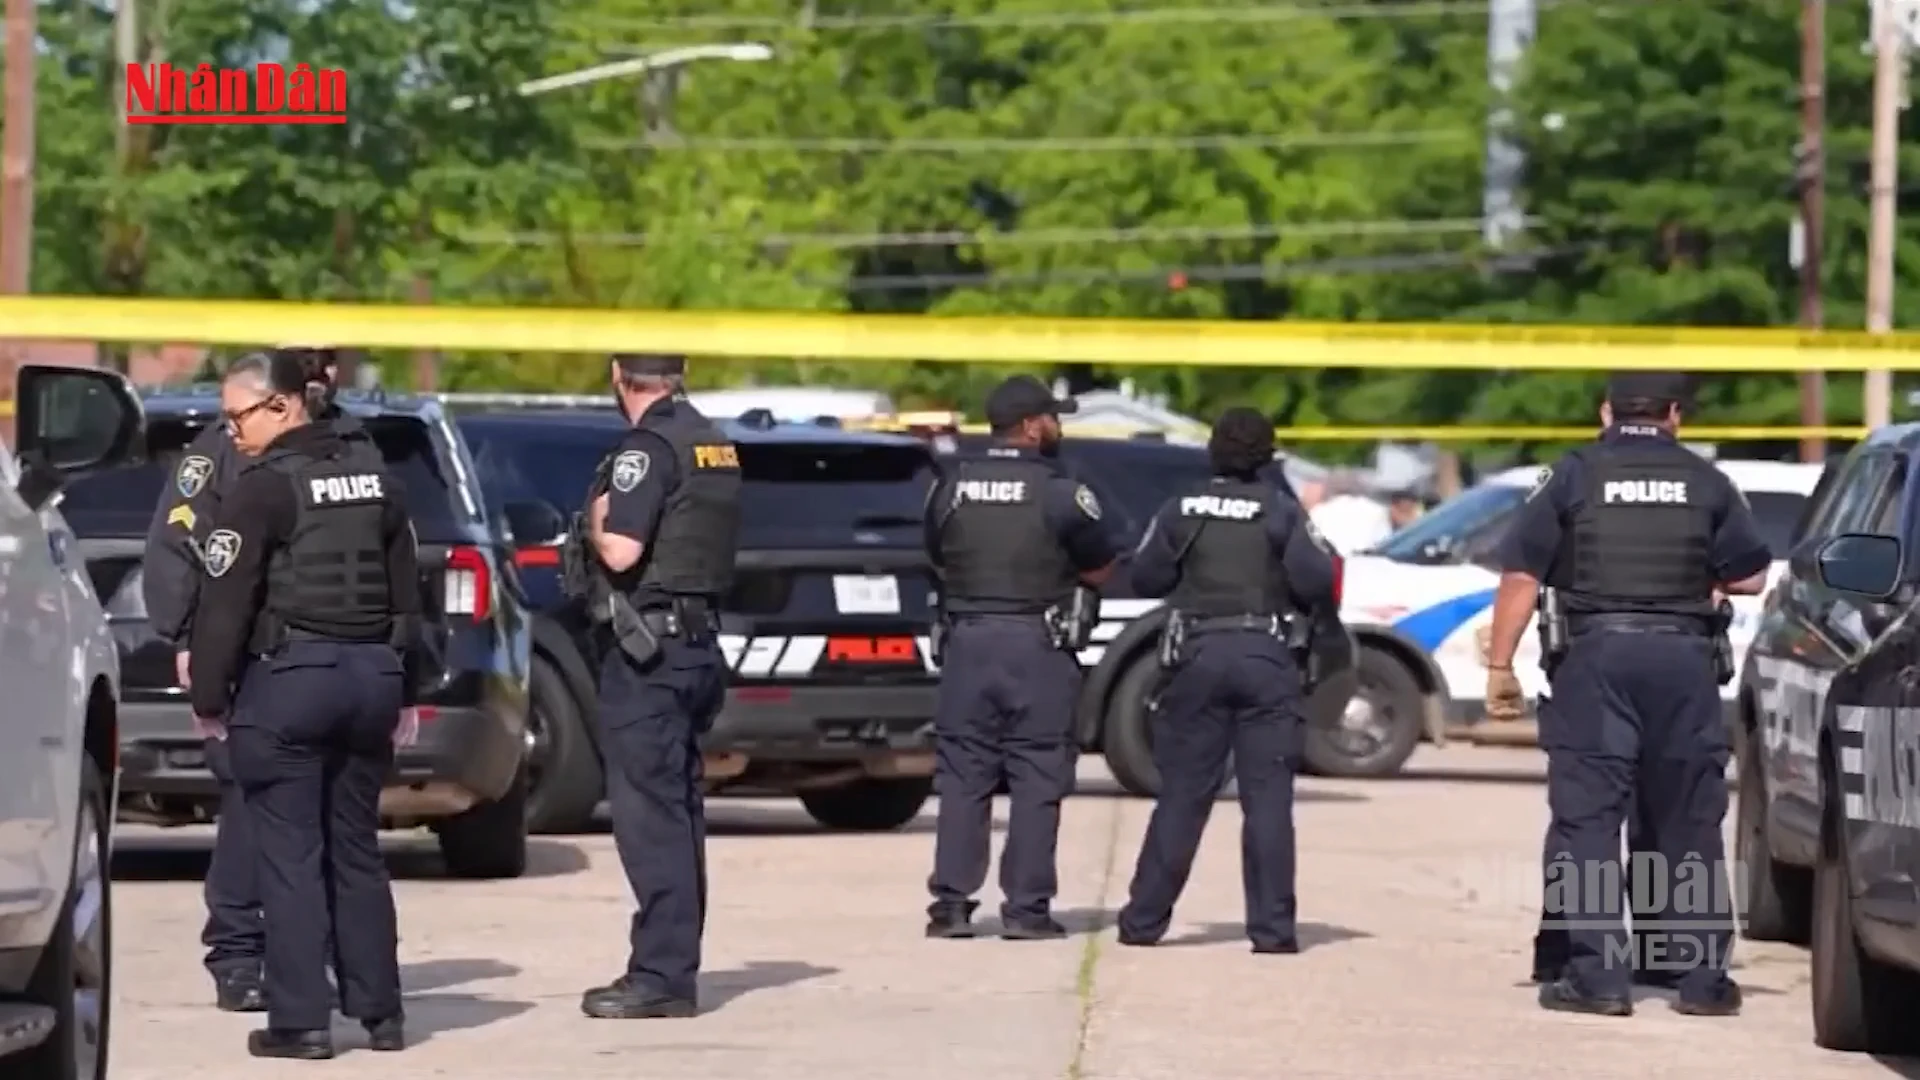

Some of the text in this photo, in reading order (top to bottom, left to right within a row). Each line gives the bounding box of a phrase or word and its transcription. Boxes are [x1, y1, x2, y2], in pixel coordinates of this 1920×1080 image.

[310, 474, 384, 505] POLICE
[955, 481, 1027, 502] POLICE
[1604, 480, 1687, 503] POLICE
